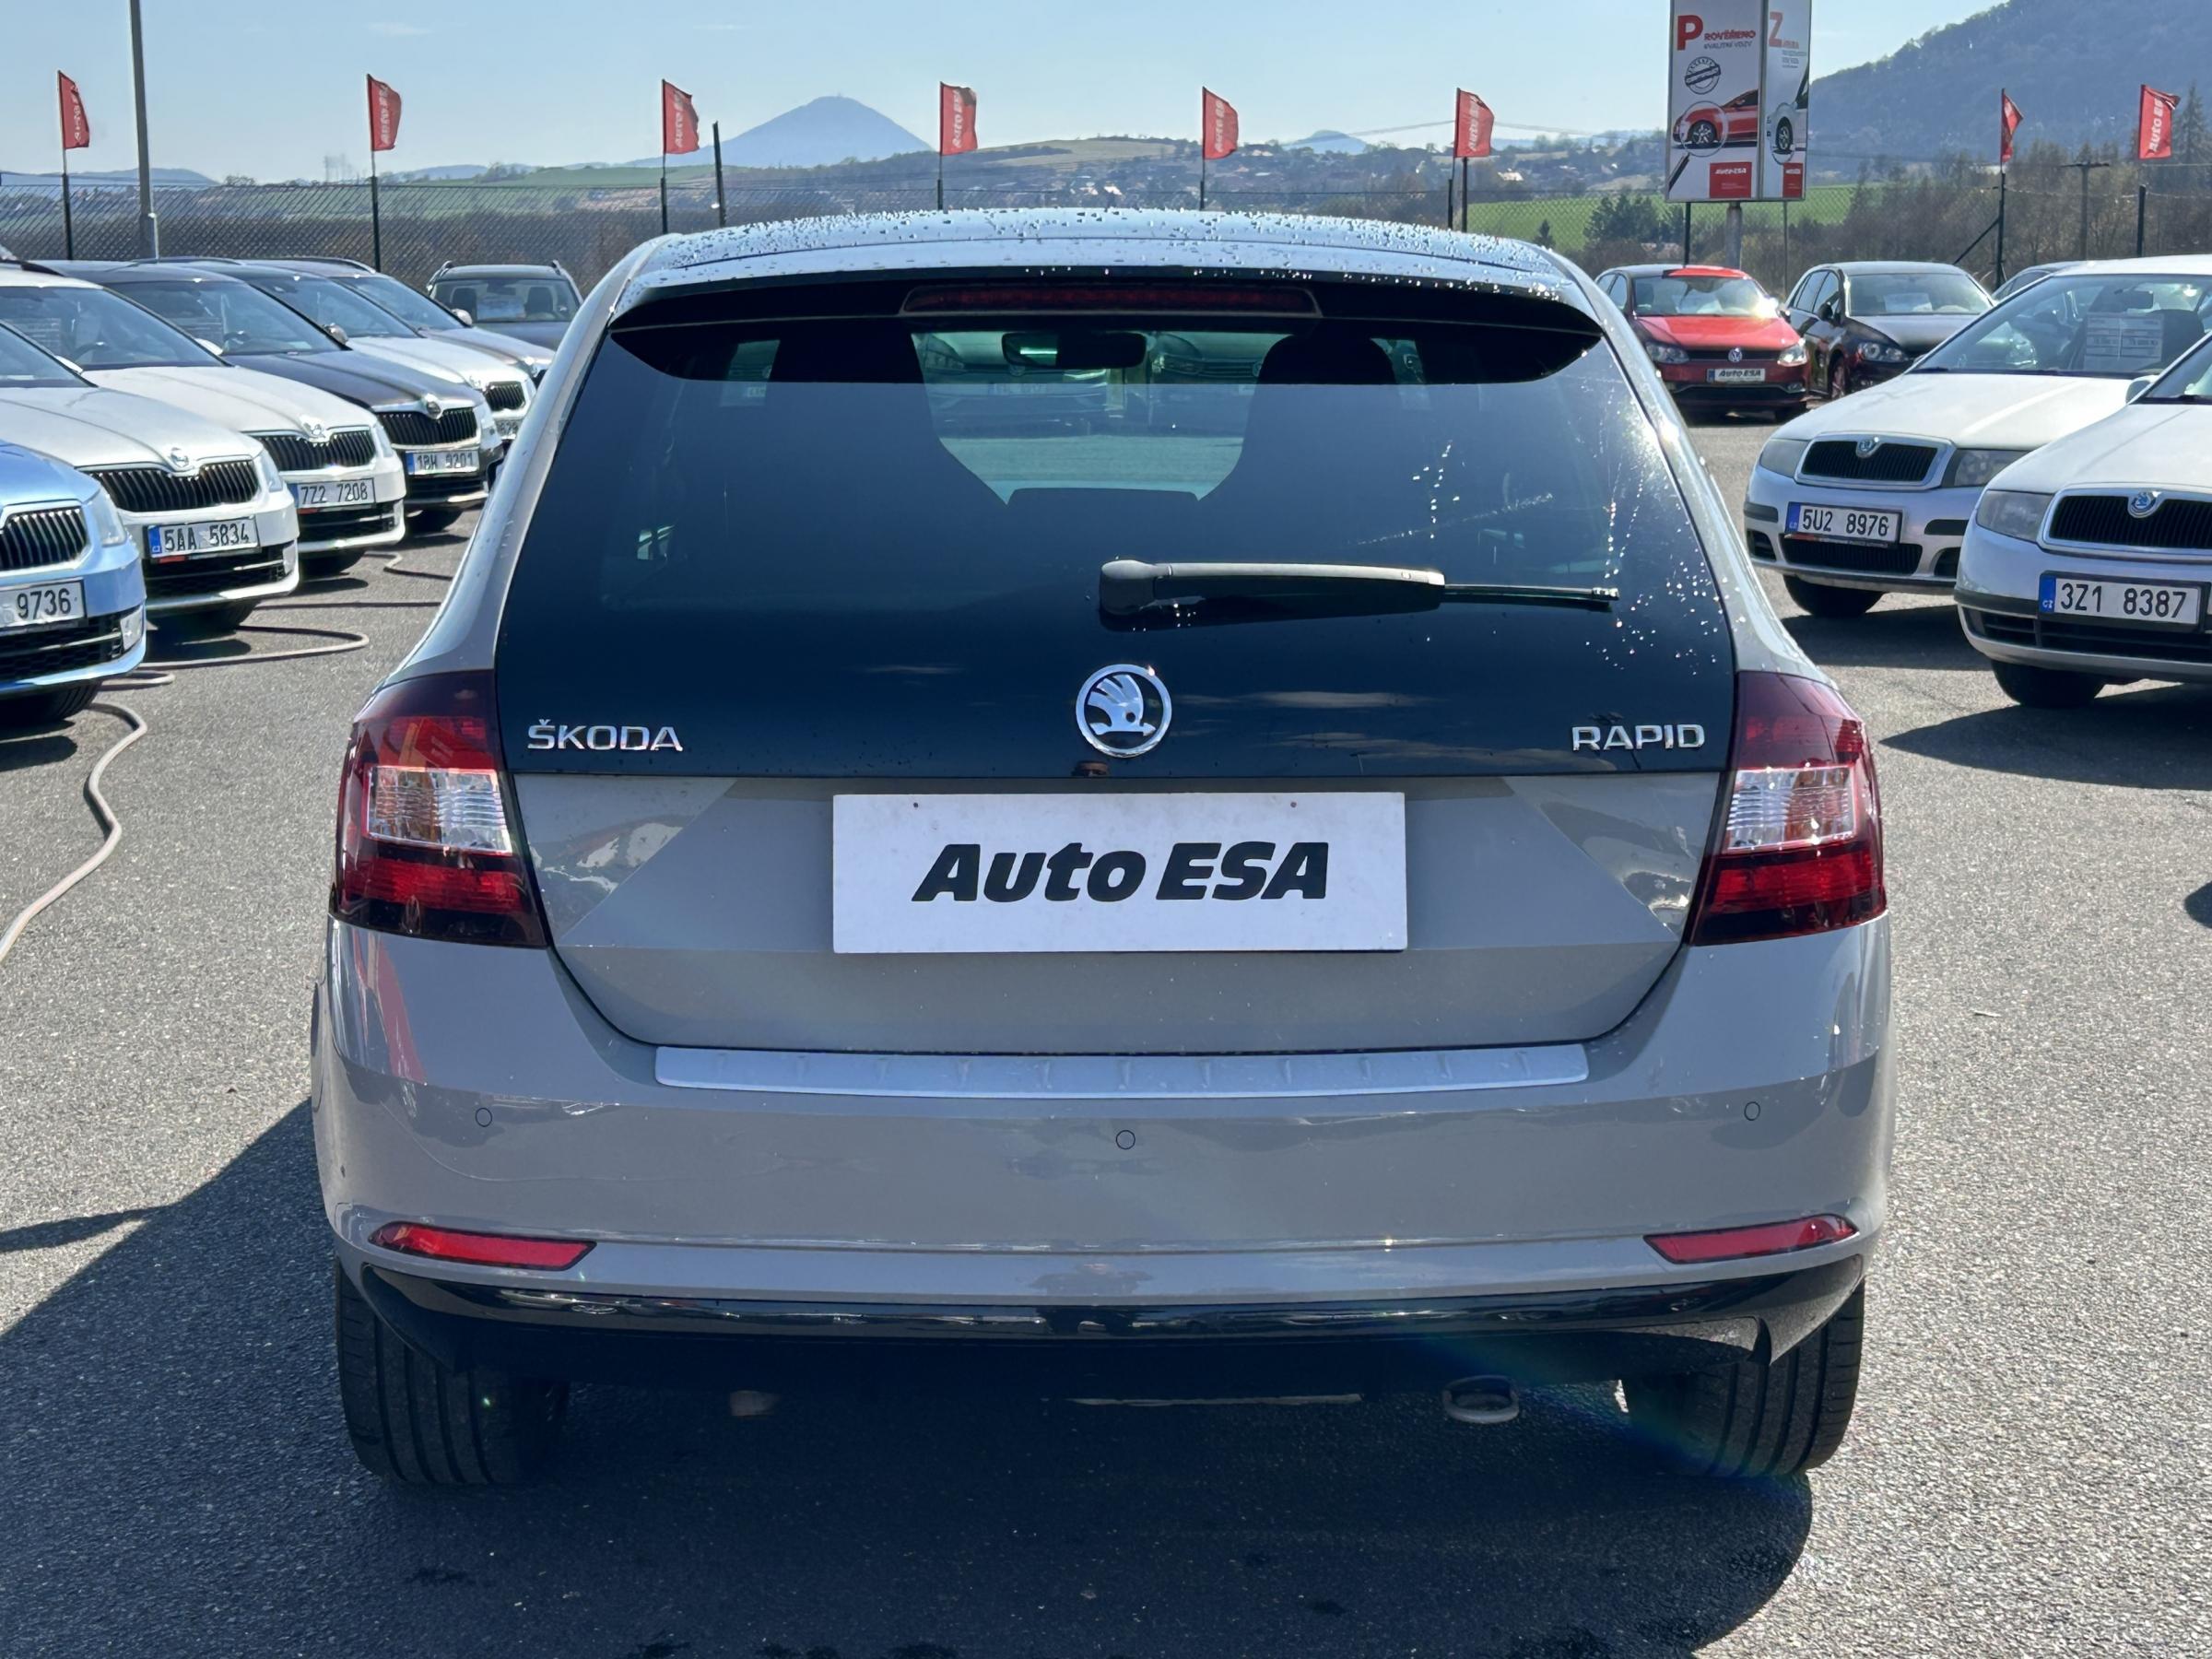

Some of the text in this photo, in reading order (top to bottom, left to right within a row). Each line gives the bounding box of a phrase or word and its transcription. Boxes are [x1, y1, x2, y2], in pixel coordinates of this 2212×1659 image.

[301, 481, 368, 504] 7Z2 7208
[164, 523, 250, 551] 5AA 5834
[1802, 509, 1889, 536] 5U2 8976
[17, 588, 71, 620] 9736
[2061, 582, 2187, 618] 3Z1 8387
[527, 719, 683, 752] ŠKODA
[1571, 724, 1705, 751] RAPID
[911, 841, 1329, 902] Auto ESA
